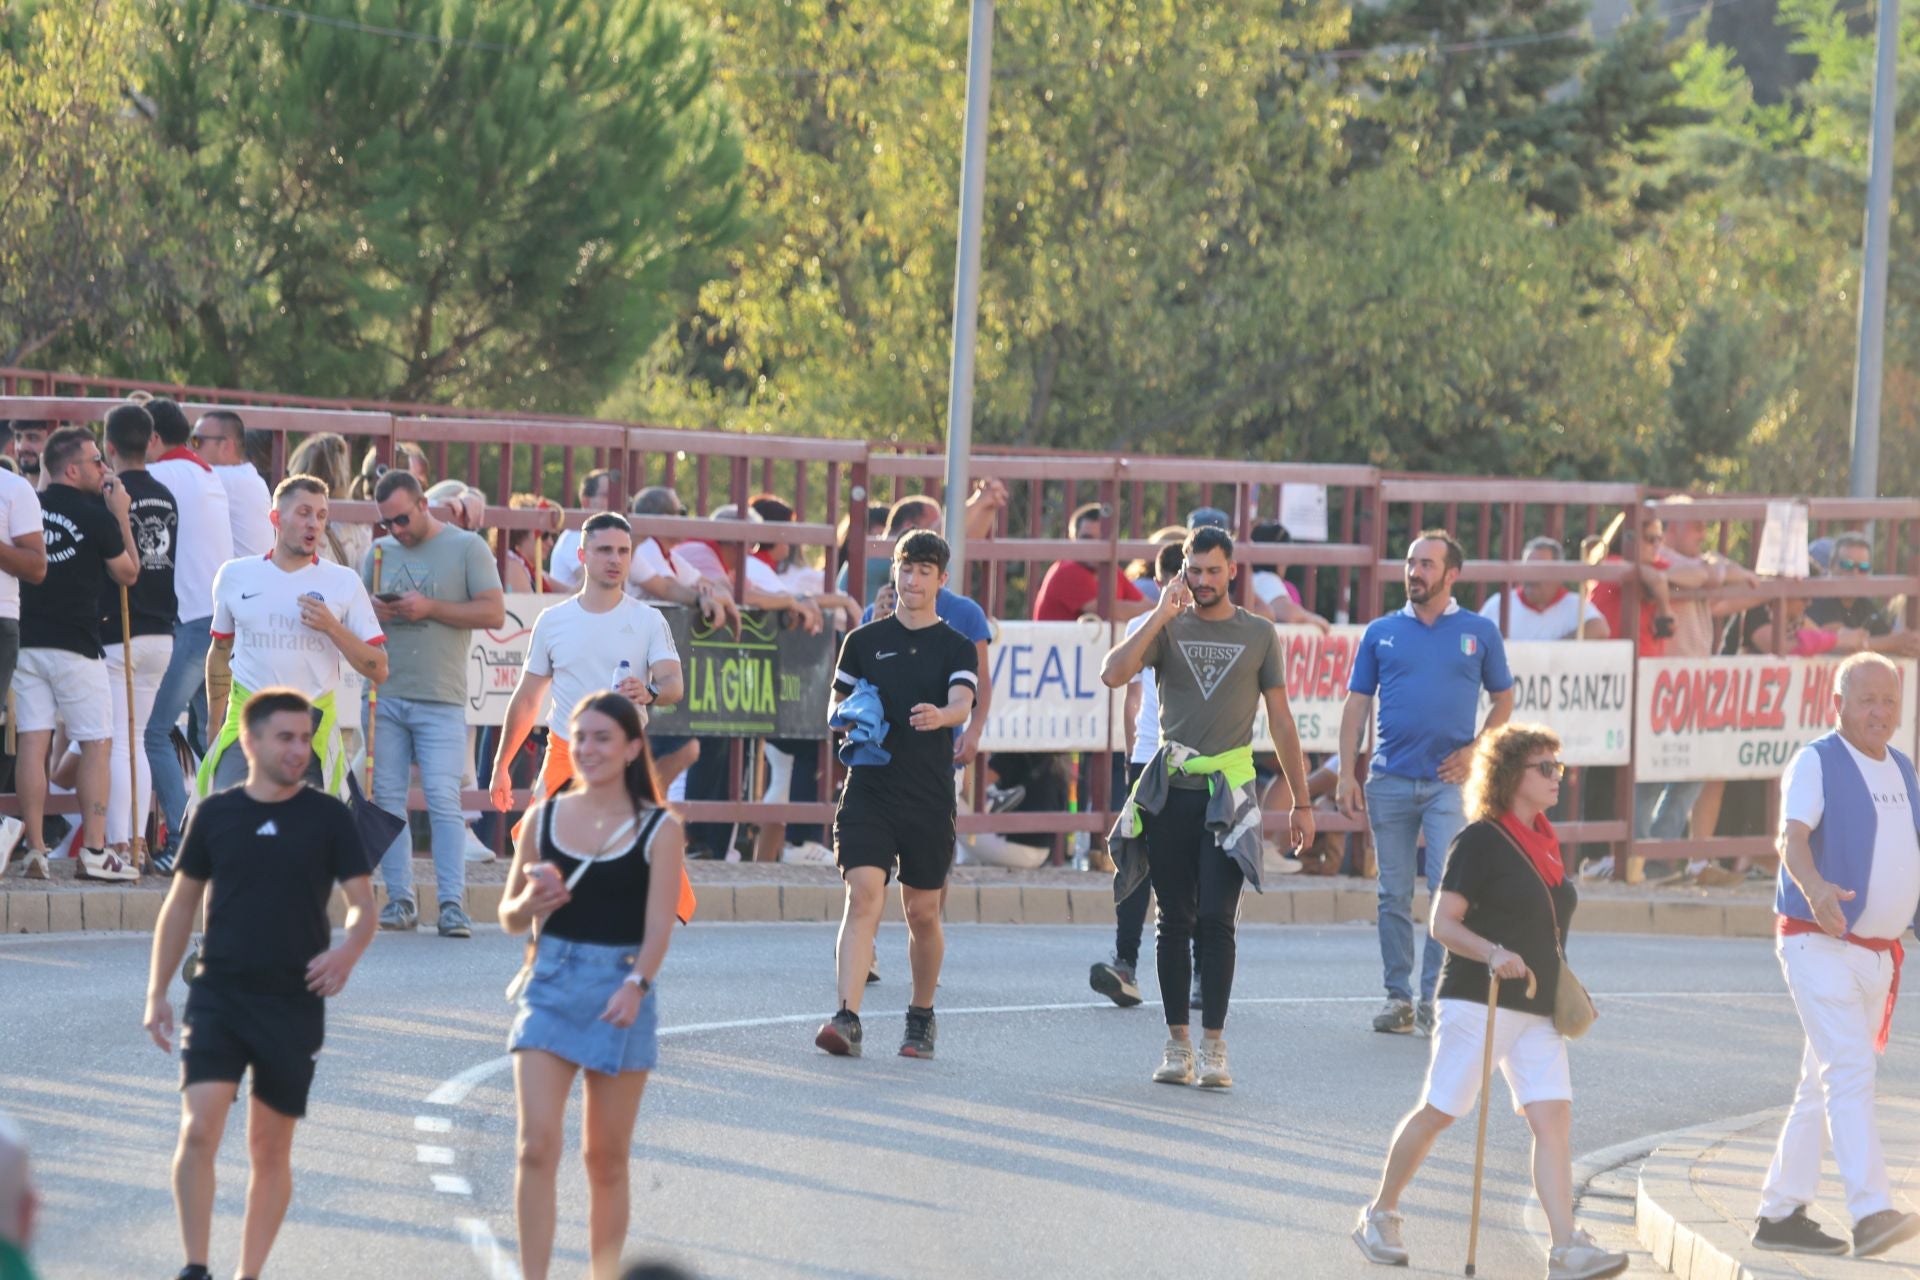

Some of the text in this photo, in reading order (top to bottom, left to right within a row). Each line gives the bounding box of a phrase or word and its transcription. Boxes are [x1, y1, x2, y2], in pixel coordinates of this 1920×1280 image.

[268, 614, 296, 630] Fly
[242, 627, 326, 652] Emirates
[1187, 645, 1233, 660] GUESS
[689, 656, 717, 712] LA
[1558, 673, 1626, 712] SANZU
[1651, 667, 1791, 736] GONZALEZ
